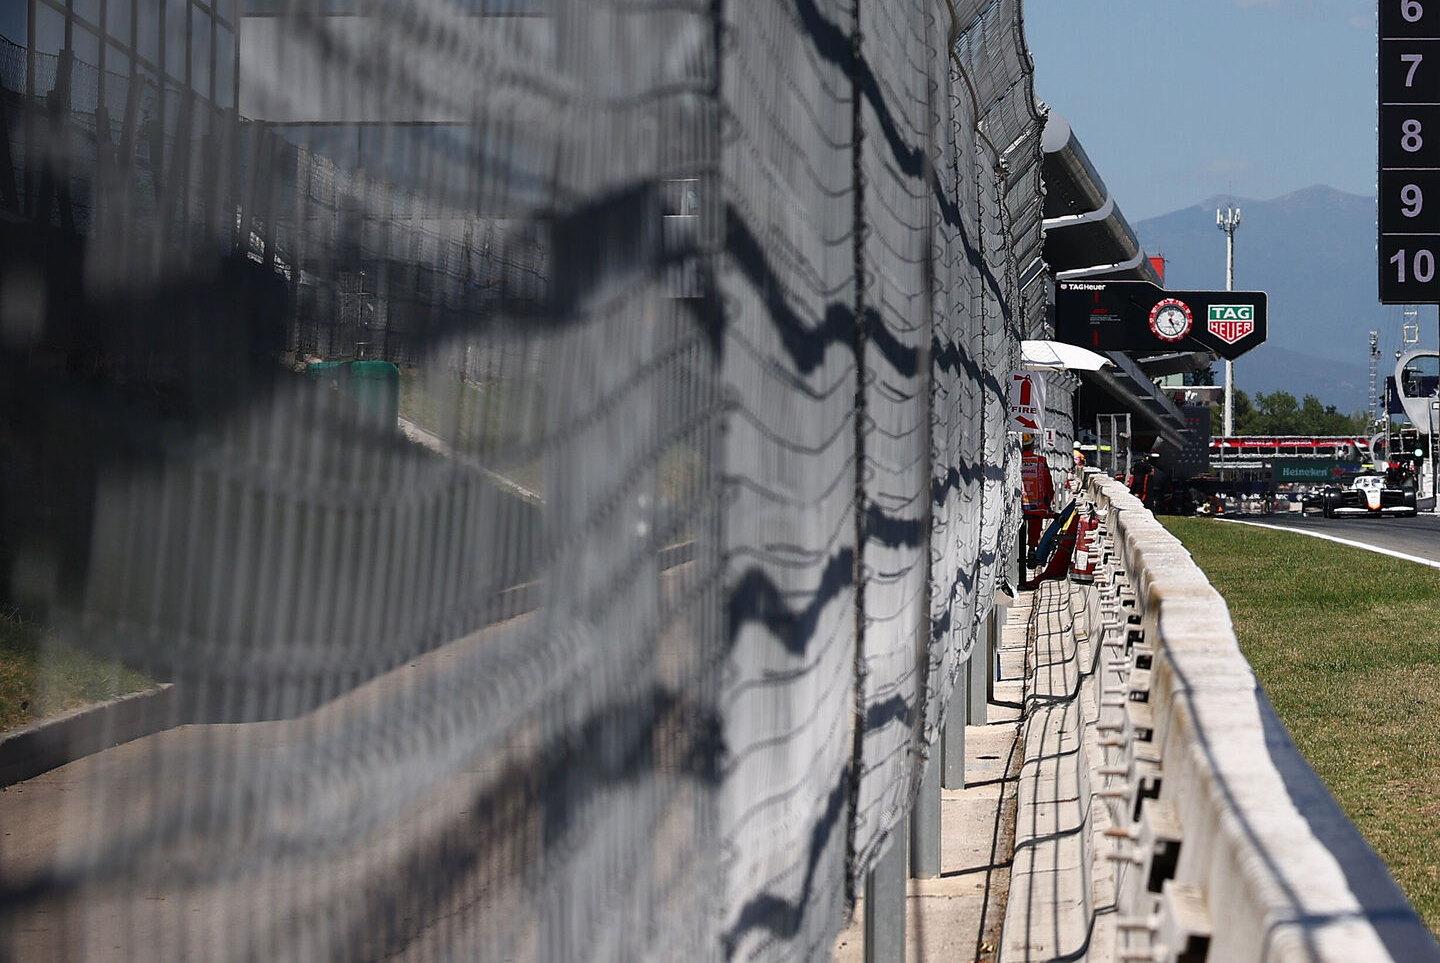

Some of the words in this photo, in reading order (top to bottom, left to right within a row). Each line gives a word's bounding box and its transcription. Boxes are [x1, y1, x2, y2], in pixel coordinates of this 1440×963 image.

[1400, 54, 1423, 87] 7
[1400, 119, 1423, 153] 8
[1400, 184, 1423, 218] 9
[1389, 249, 1435, 283] 10
[1212, 307, 1250, 320] TAG
[1209, 321, 1252, 342] HEUER
[1012, 406, 1037, 414] FIRE
[1282, 467, 1328, 477] Heineken
